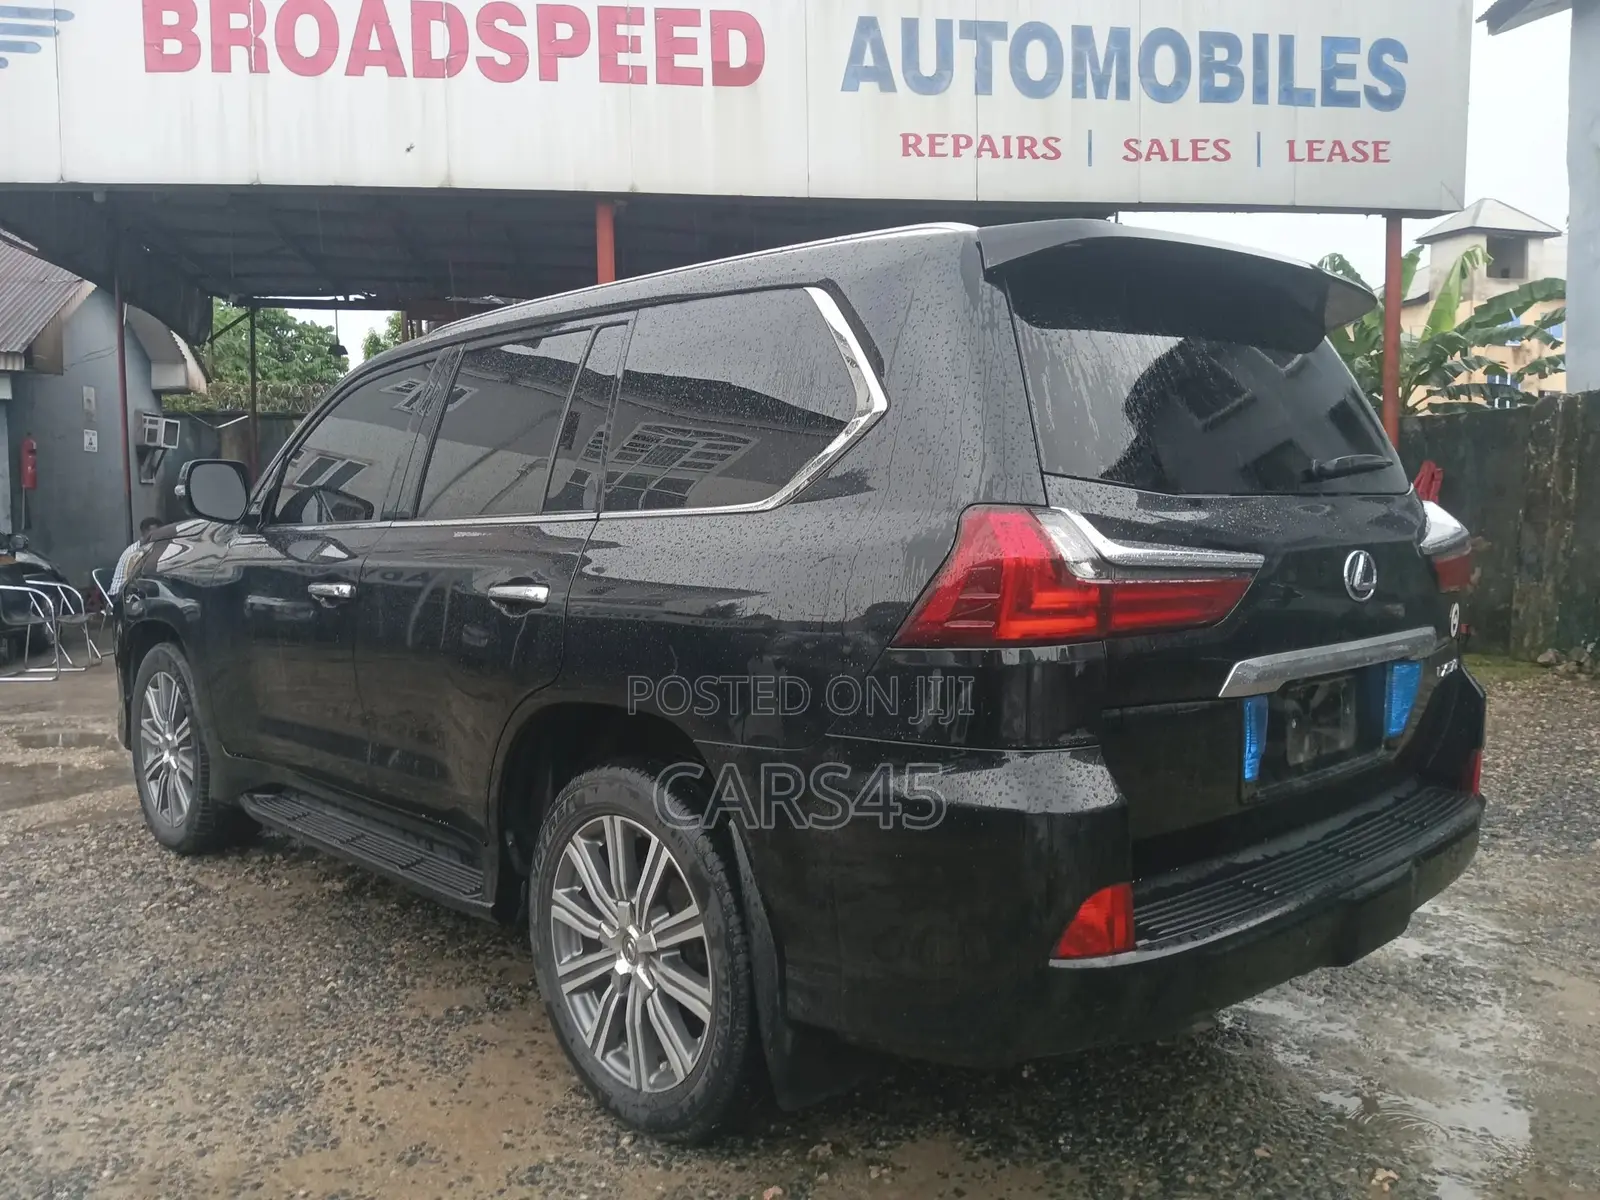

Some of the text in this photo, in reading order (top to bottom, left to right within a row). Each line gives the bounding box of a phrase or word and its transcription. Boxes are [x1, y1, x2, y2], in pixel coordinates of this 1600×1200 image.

[142, 0, 1409, 112] BROADSPEED AUTOMOBILES
[899, 132, 1391, 163] REPAIRS SALES LEASE
